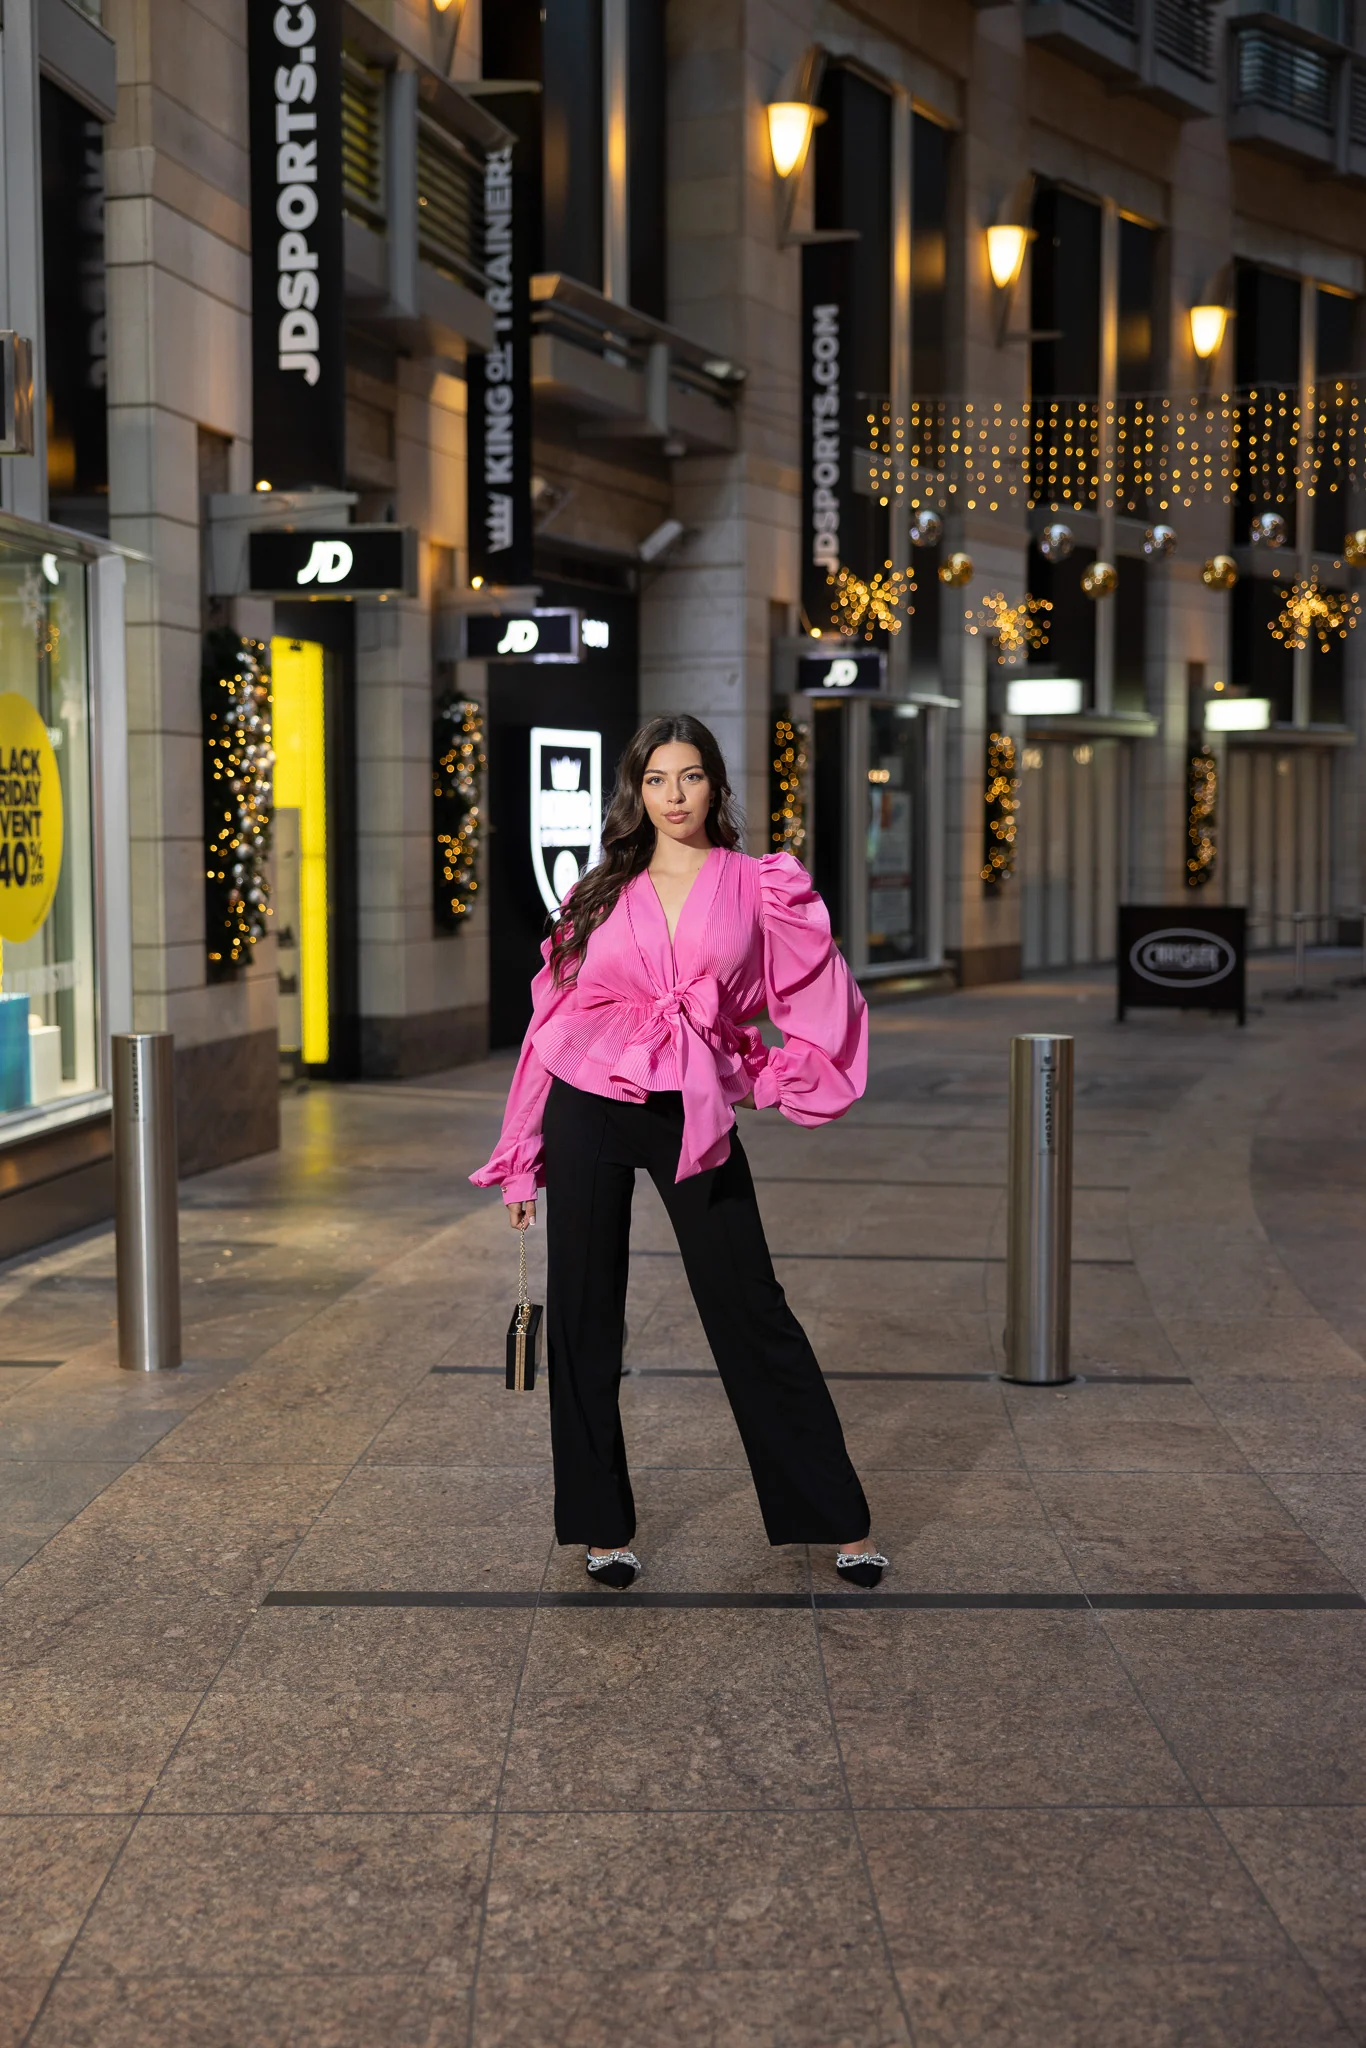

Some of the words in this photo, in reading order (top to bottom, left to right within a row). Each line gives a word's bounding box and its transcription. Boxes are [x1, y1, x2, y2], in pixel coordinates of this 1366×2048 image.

[273, 0, 320, 386] JDSPORTS.C
[485, 386, 513, 484] KING
[812, 303, 840, 573] JDSPORTS.COM
[297, 541, 353, 584] JD
[497, 620, 539, 654] JD
[823, 659, 858, 687] JD
[0, 746, 41, 776] LACK
[0, 780, 41, 806] RIDAY
[0, 810, 42, 837] VENT
